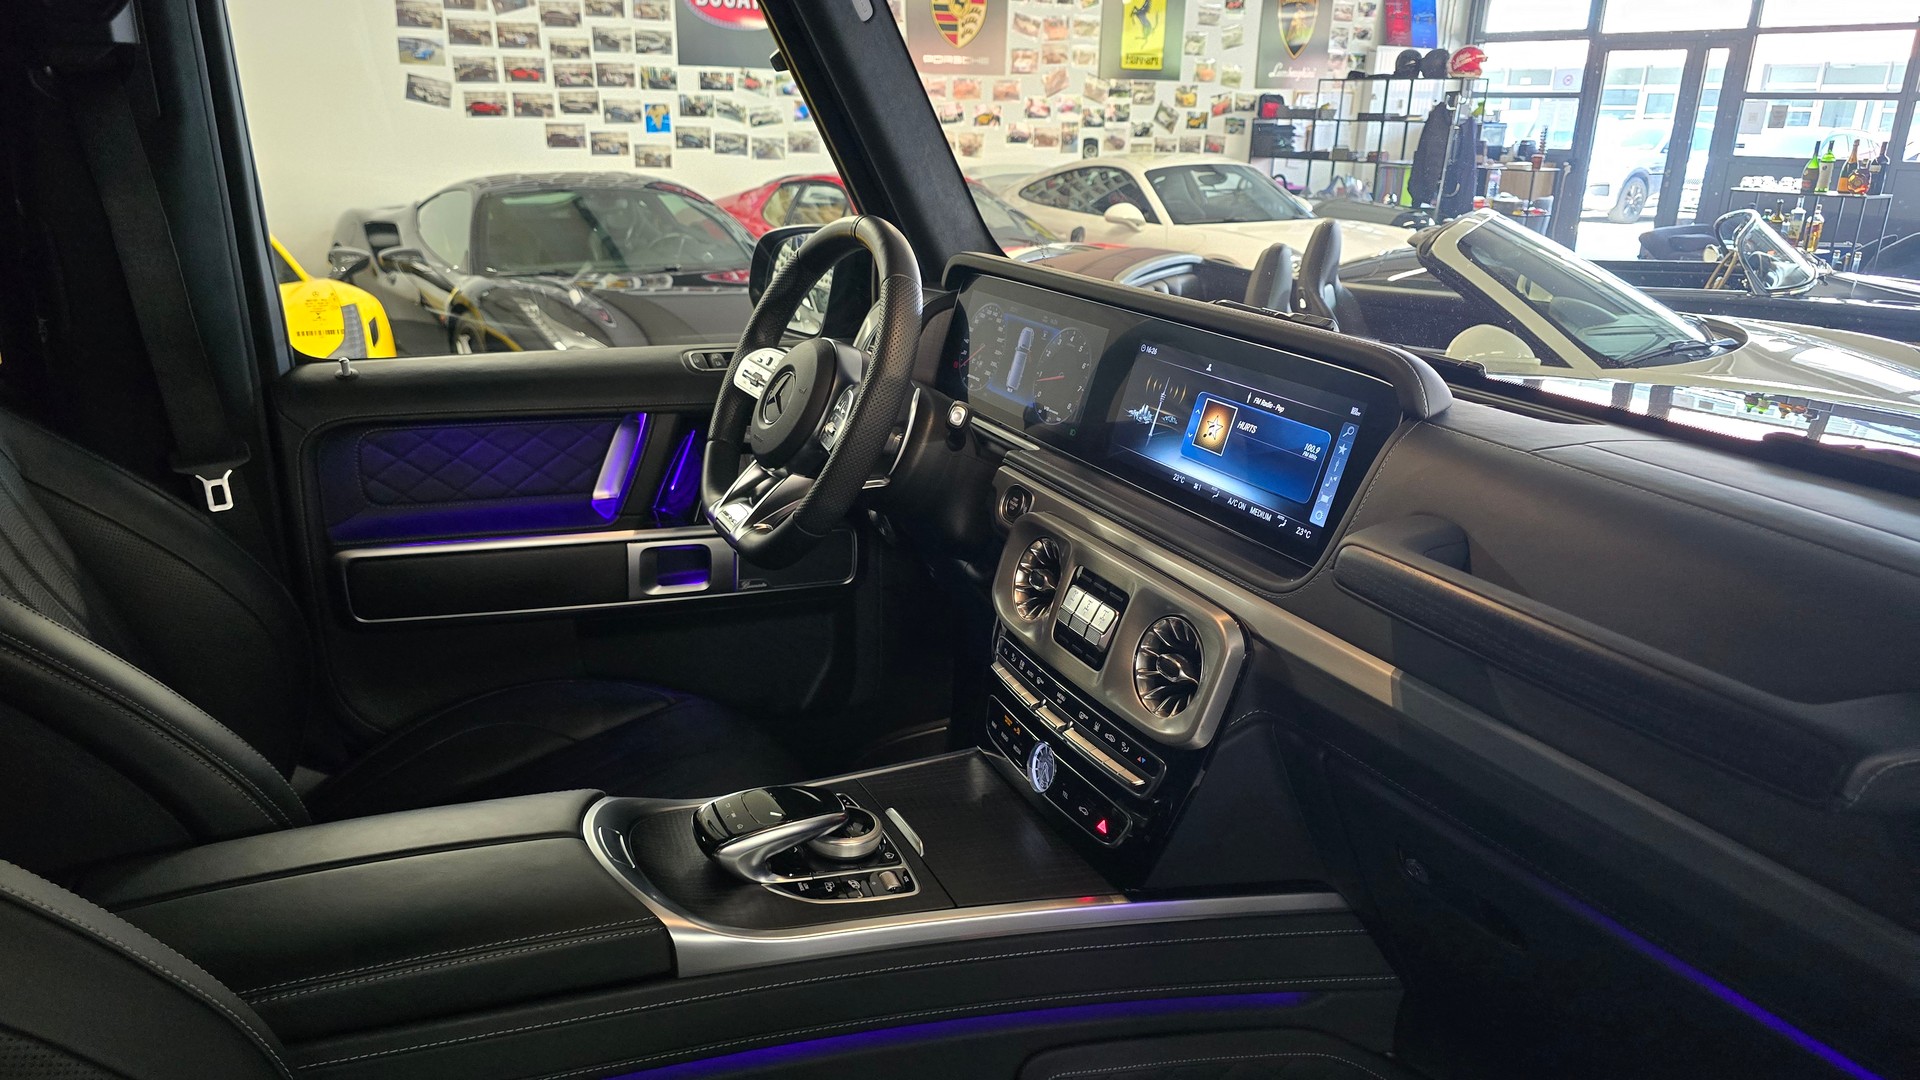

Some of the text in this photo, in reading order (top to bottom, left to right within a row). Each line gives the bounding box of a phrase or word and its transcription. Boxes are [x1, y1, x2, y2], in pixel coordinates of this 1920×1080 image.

[1253, 397, 1262, 405] FM
[1260, 399, 1274, 410] Radio
[1274, 404, 1285, 414] Pop
[1236, 420, 1258, 434] HURTS
[1303, 442, 1321, 455] 100.9
[1172, 473, 1186, 484] 23°C
[1227, 497, 1247, 511] A/C ON
[1249, 506, 1272, 522] MEDIUM
[1295, 526, 1312, 539] 23°C
